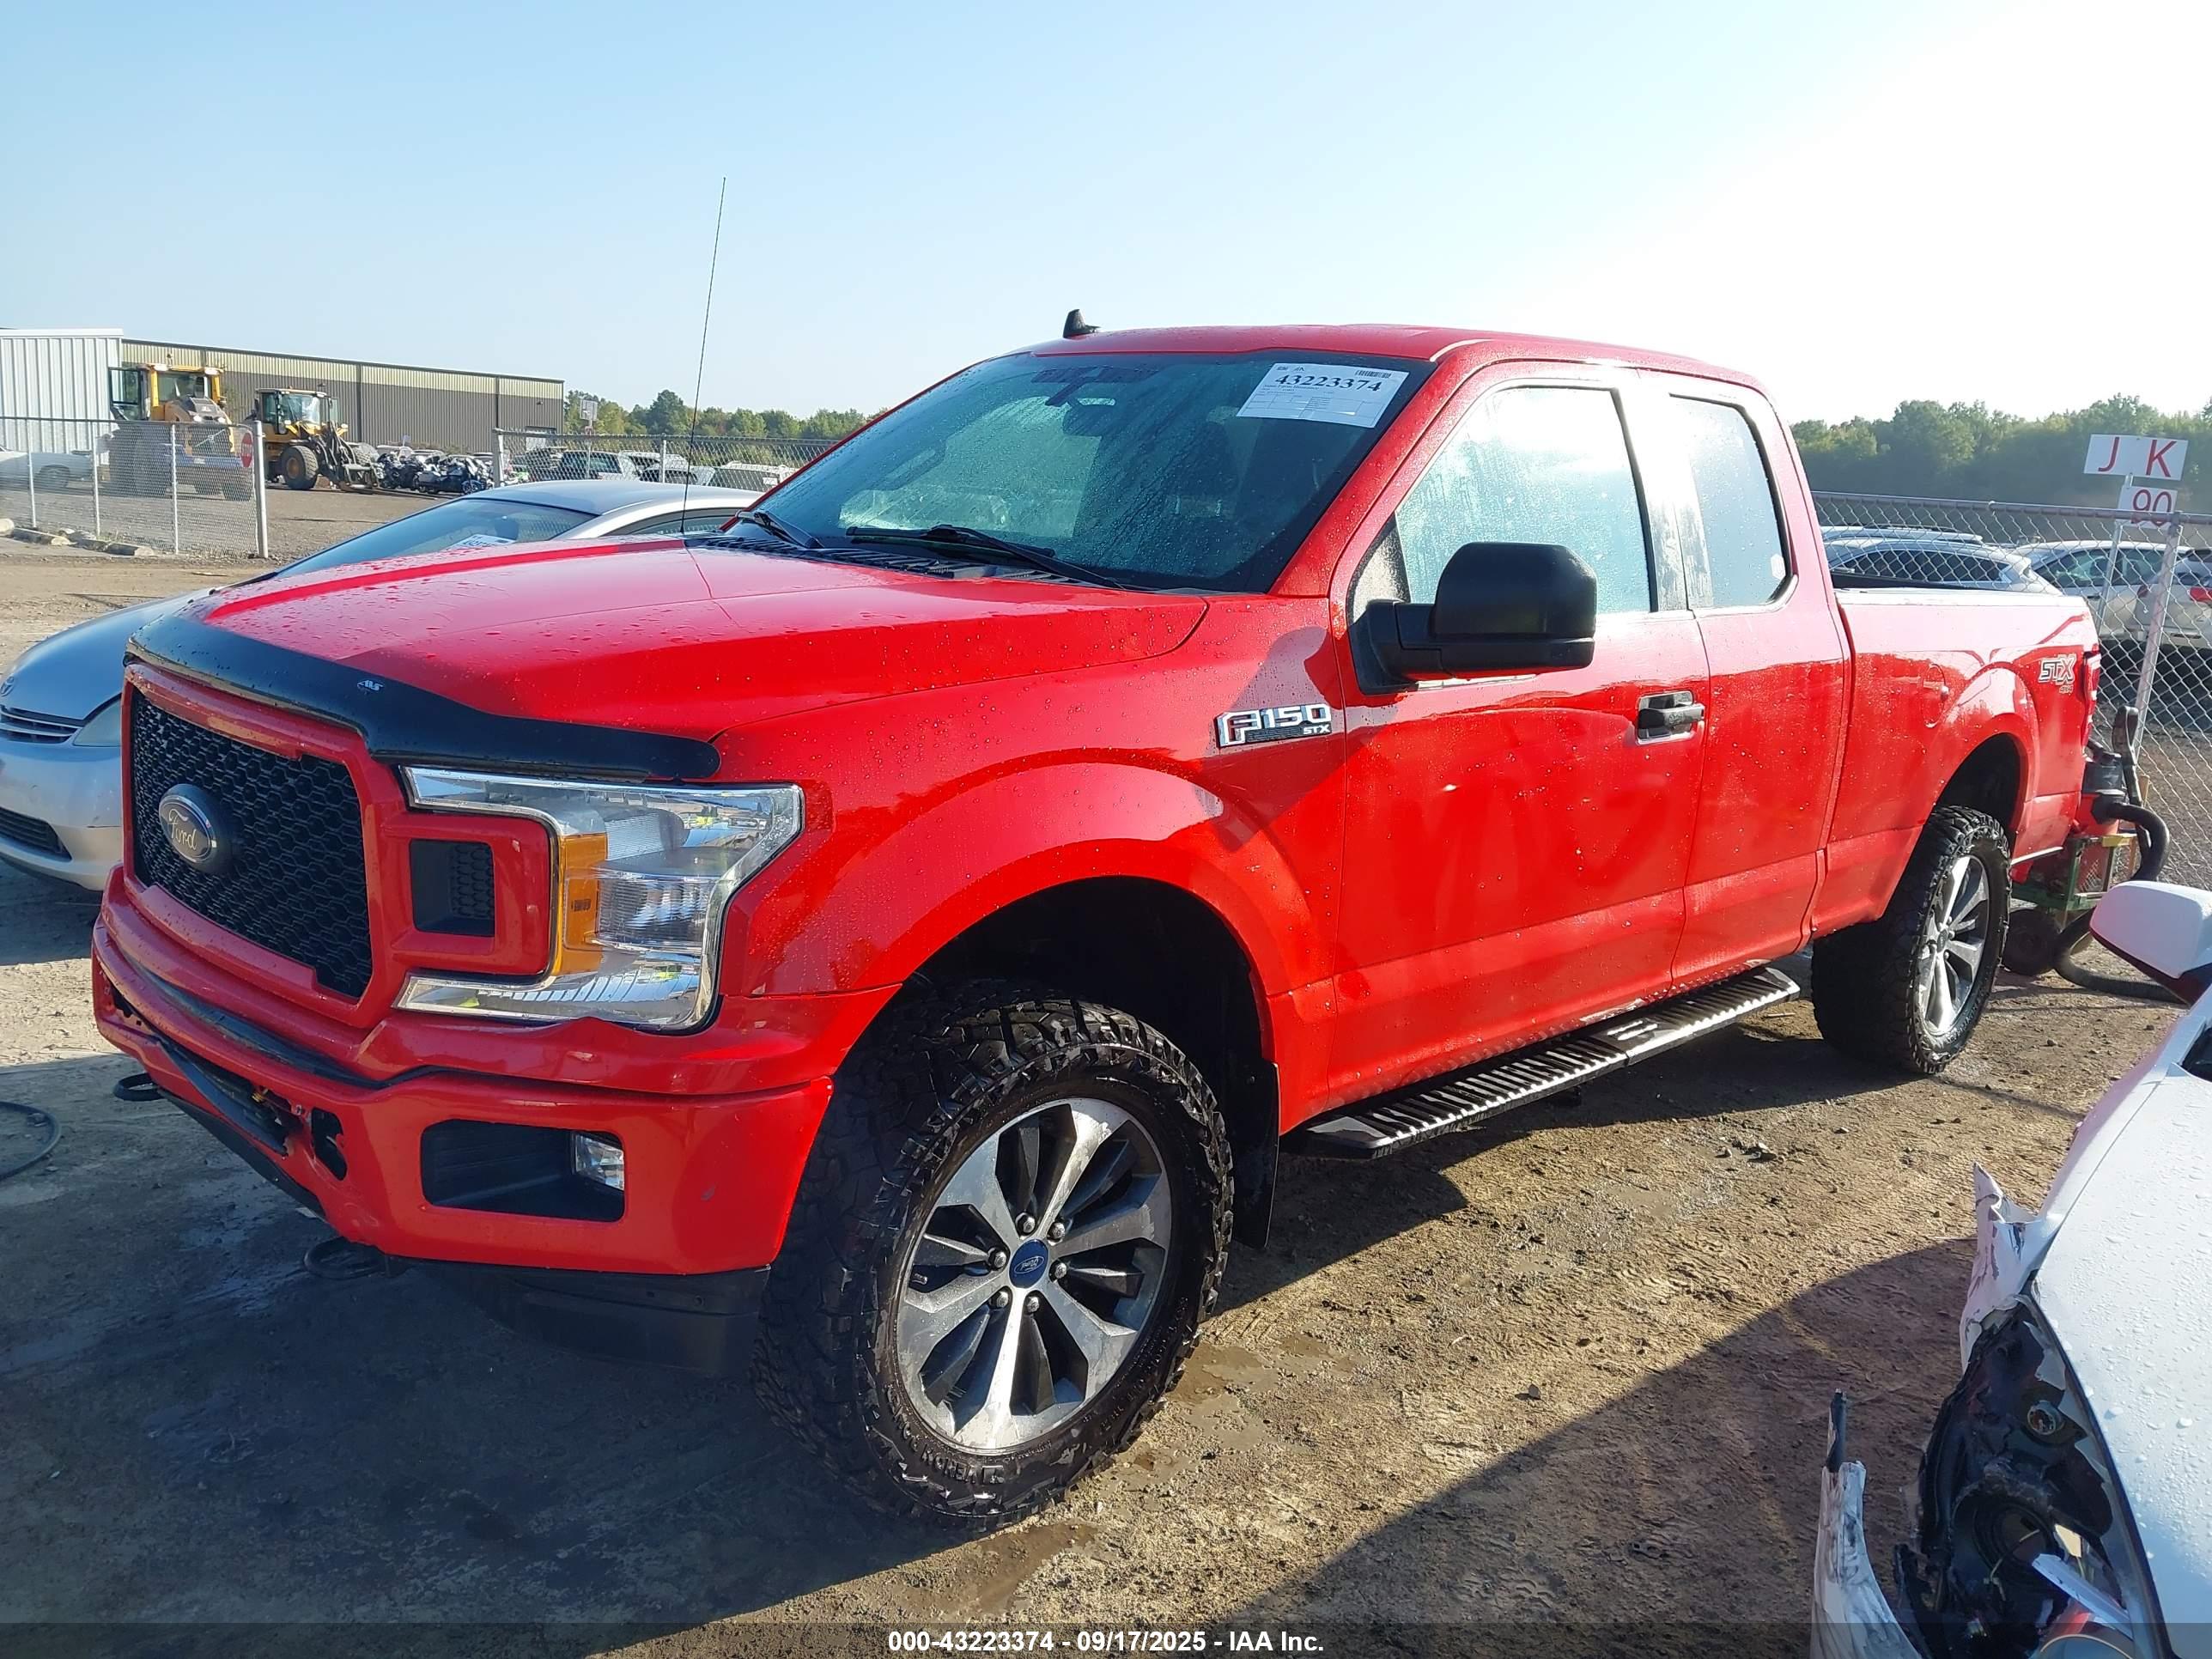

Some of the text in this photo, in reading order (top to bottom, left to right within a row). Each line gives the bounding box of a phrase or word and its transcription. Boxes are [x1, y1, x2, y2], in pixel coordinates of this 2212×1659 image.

[1275, 374, 1383, 392] 43223374
[2098, 437, 2178, 477] J K
[2130, 489, 2172, 526] 90
[2039, 653, 2076, 685] STX
[1303, 725, 1331, 735] STX
[168, 808, 198, 851] Ford
